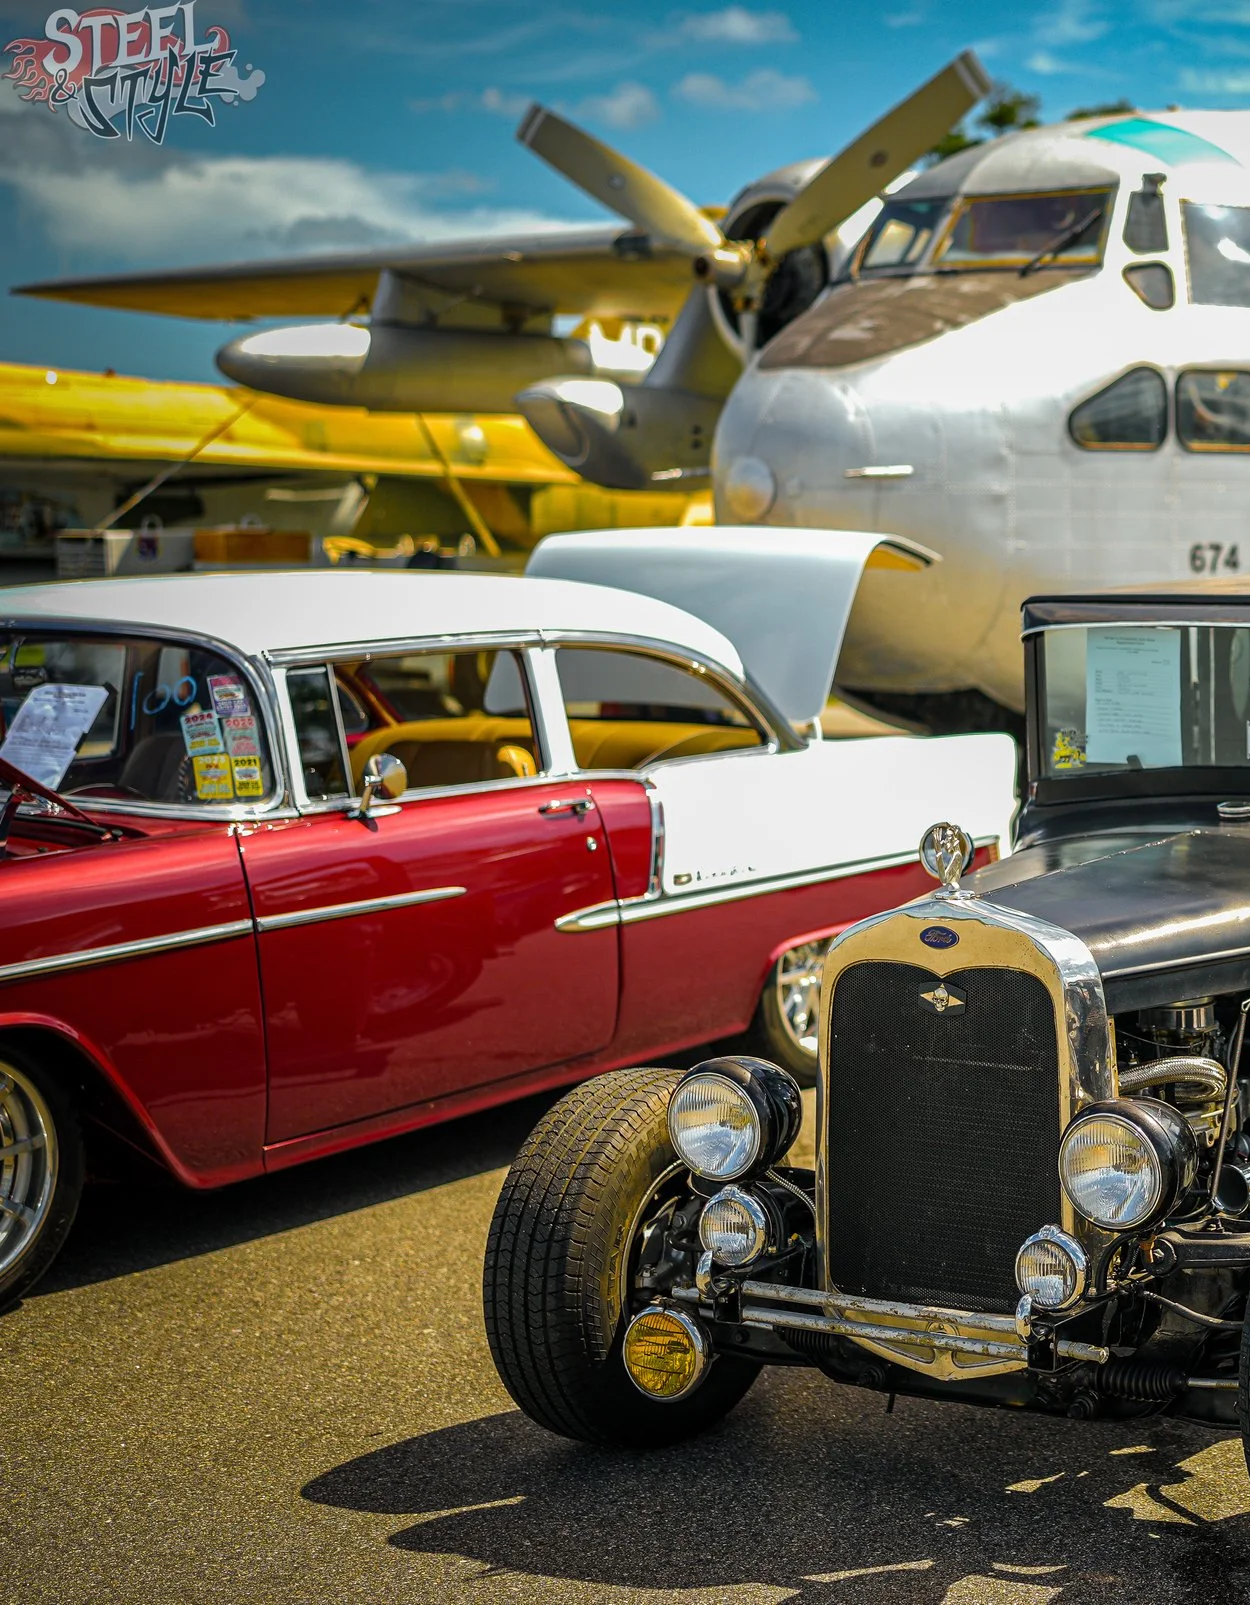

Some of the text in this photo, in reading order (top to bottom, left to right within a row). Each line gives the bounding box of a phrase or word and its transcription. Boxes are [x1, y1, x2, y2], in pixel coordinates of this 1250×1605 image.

[1189, 543, 1240, 574] 674
[131, 671, 197, 731] 100
[234, 758, 258, 767] 2021
[924, 929, 953, 944] Ford
